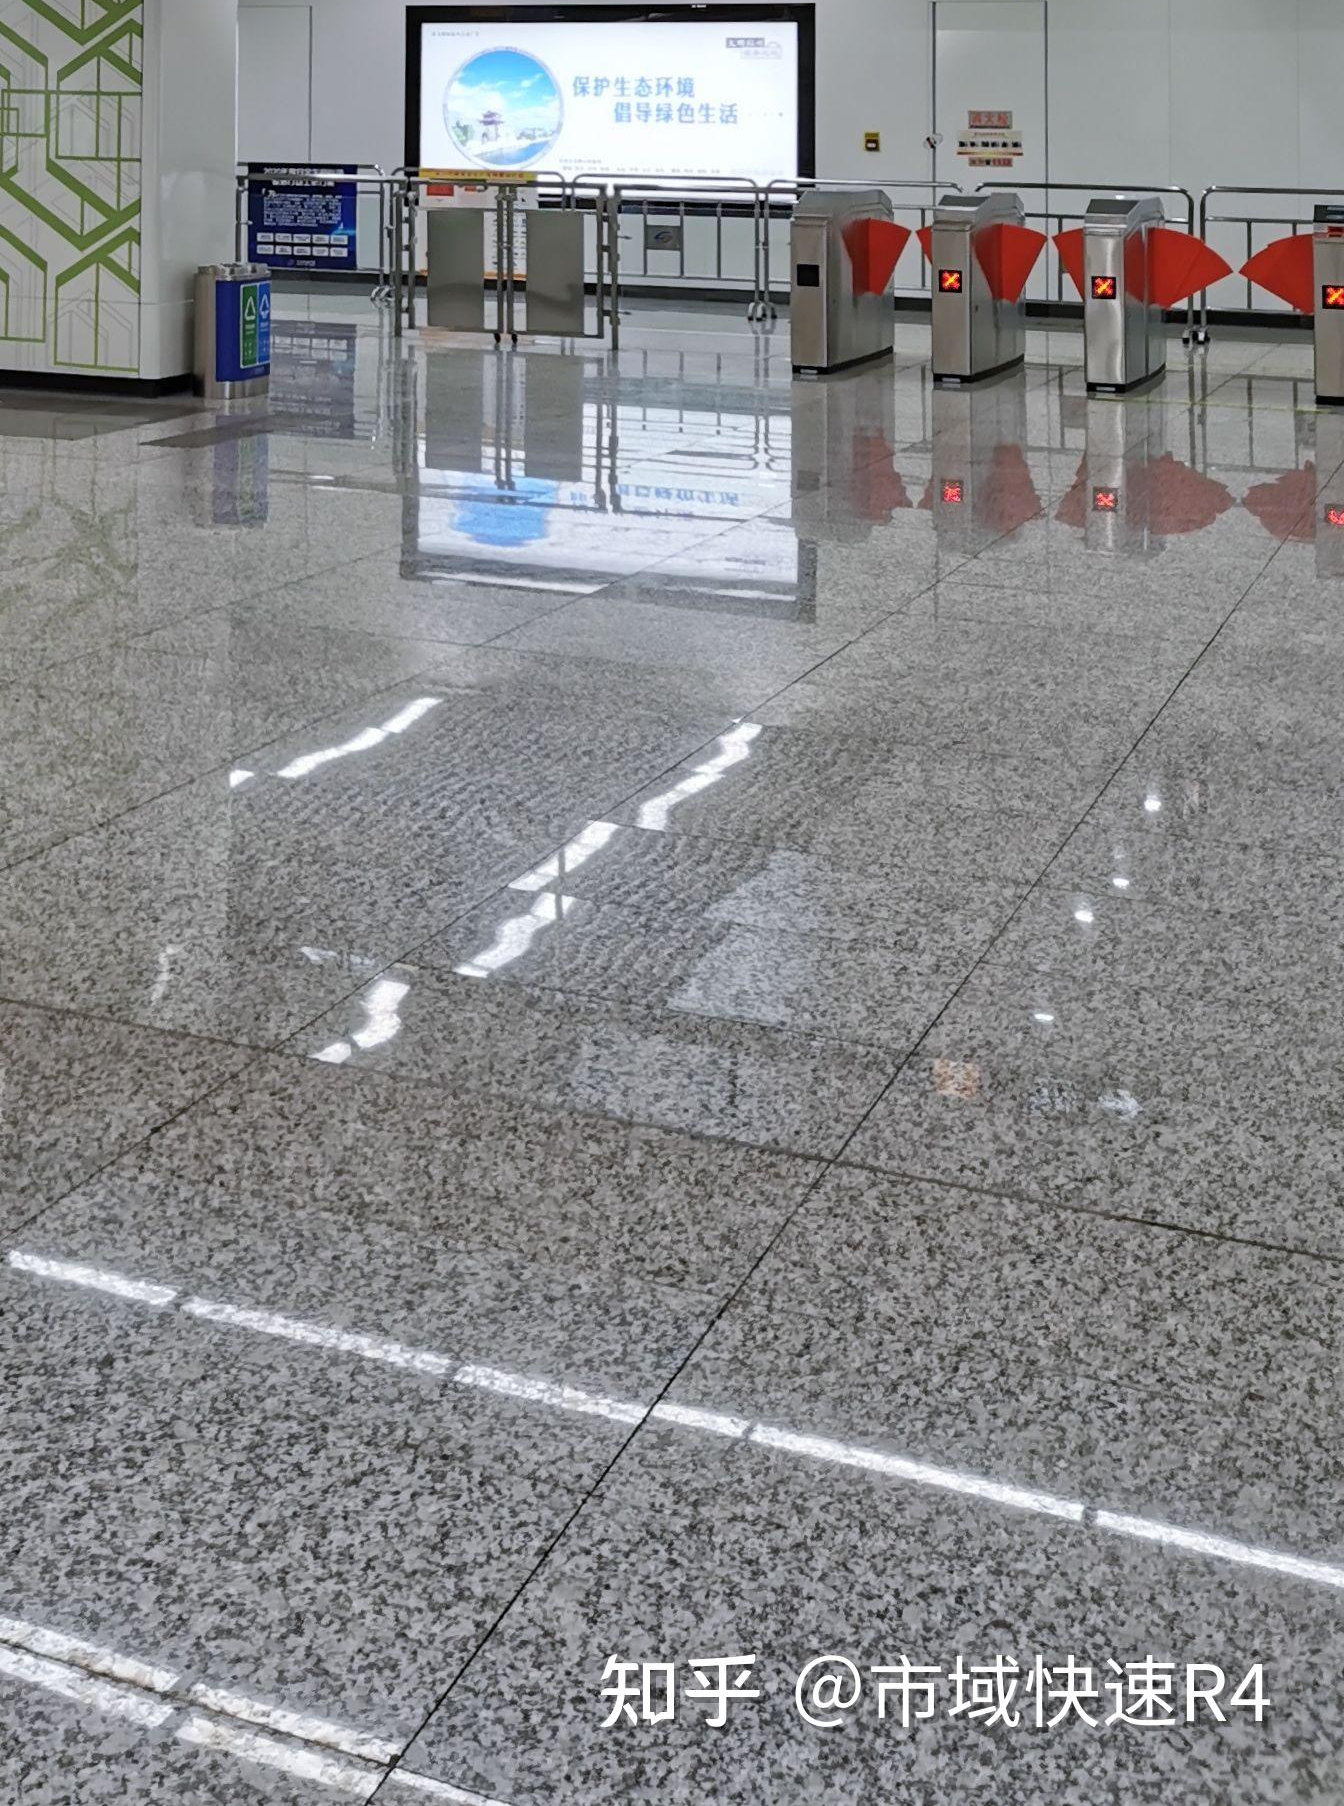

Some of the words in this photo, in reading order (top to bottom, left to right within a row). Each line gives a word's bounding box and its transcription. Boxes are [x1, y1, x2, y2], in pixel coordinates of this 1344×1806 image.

[572, 76, 696, 99] 保护生态环境
[614, 102, 739, 125] 倡导绿色生活
